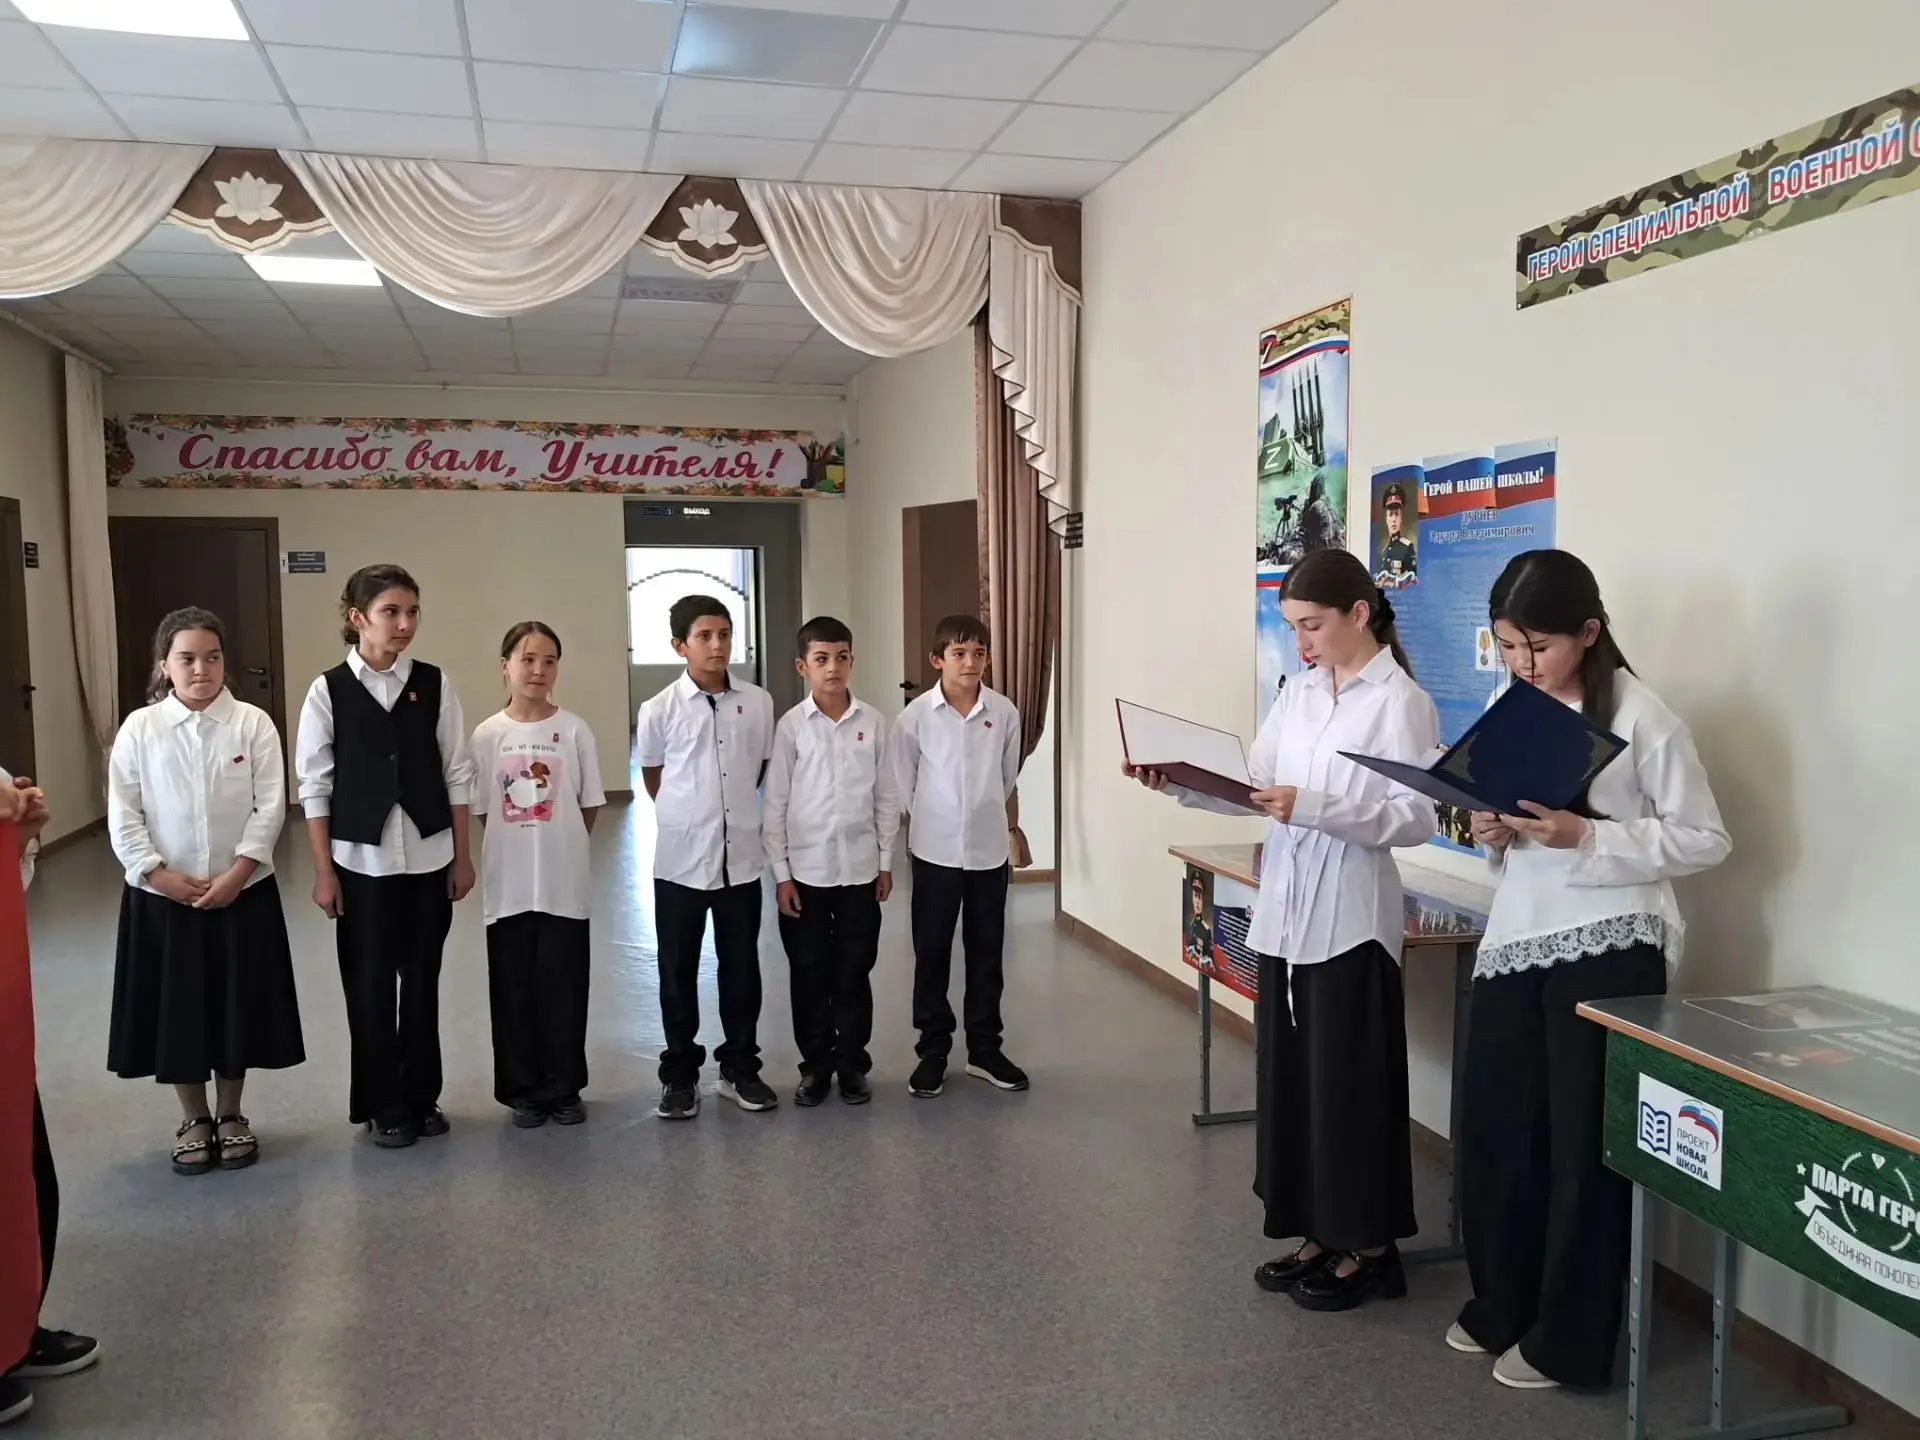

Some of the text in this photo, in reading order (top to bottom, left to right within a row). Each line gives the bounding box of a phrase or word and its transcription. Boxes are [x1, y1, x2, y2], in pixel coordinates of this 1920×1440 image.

[1526, 237, 1584, 283] ГЕРОИ
[1588, 173, 1750, 264] СПЕЦИАЛЬНОЙ
[1767, 116, 1904, 205] ВОЕННОЙ
[178, 432, 785, 482] Спасибо вам, Учителя!
[1676, 1127, 1710, 1152] ПРОЕКТ
[1676, 1141, 1708, 1165] НОВАЯ
[1676, 1155, 1709, 1181] ШКОЛА
[1811, 1162, 1920, 1236] ПАРТА ГЕР
[1874, 1259, 1920, 1290] ПОКОЛЕ
